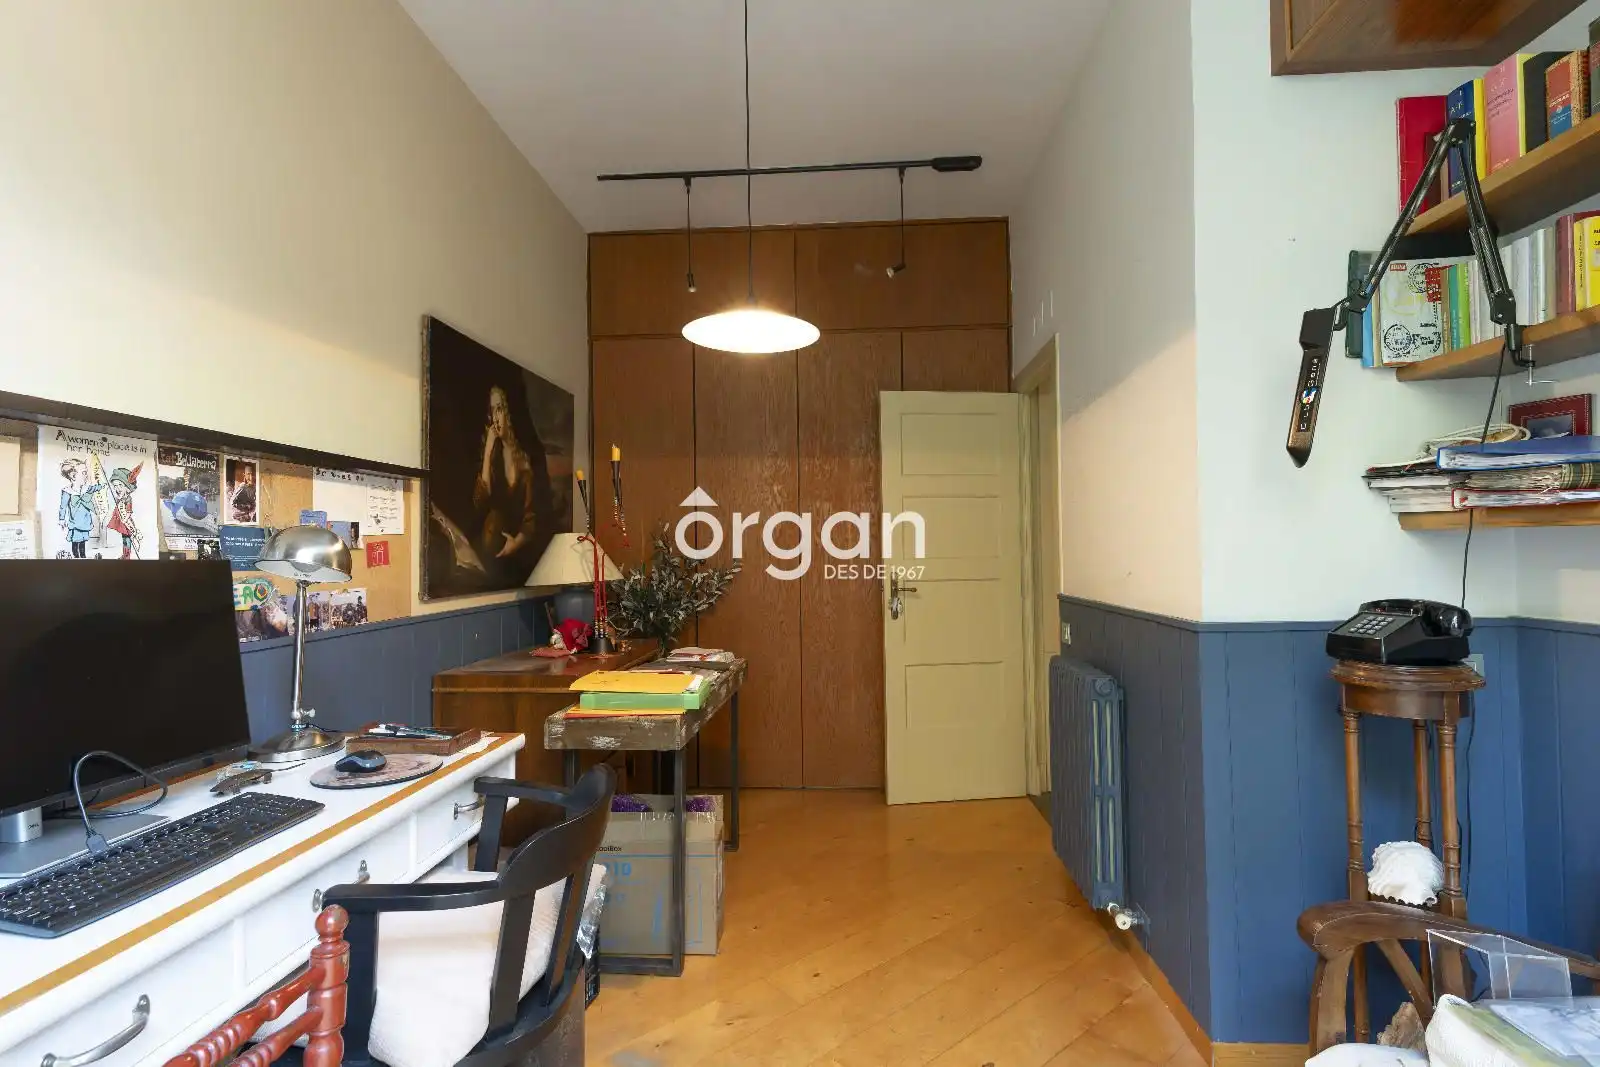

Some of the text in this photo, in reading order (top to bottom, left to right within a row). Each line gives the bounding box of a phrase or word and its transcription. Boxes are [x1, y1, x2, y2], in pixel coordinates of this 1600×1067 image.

[66, 443, 83, 453] her
[107, 440, 130, 452] place
[131, 443, 139, 453] is
[139, 446, 147, 454] in
